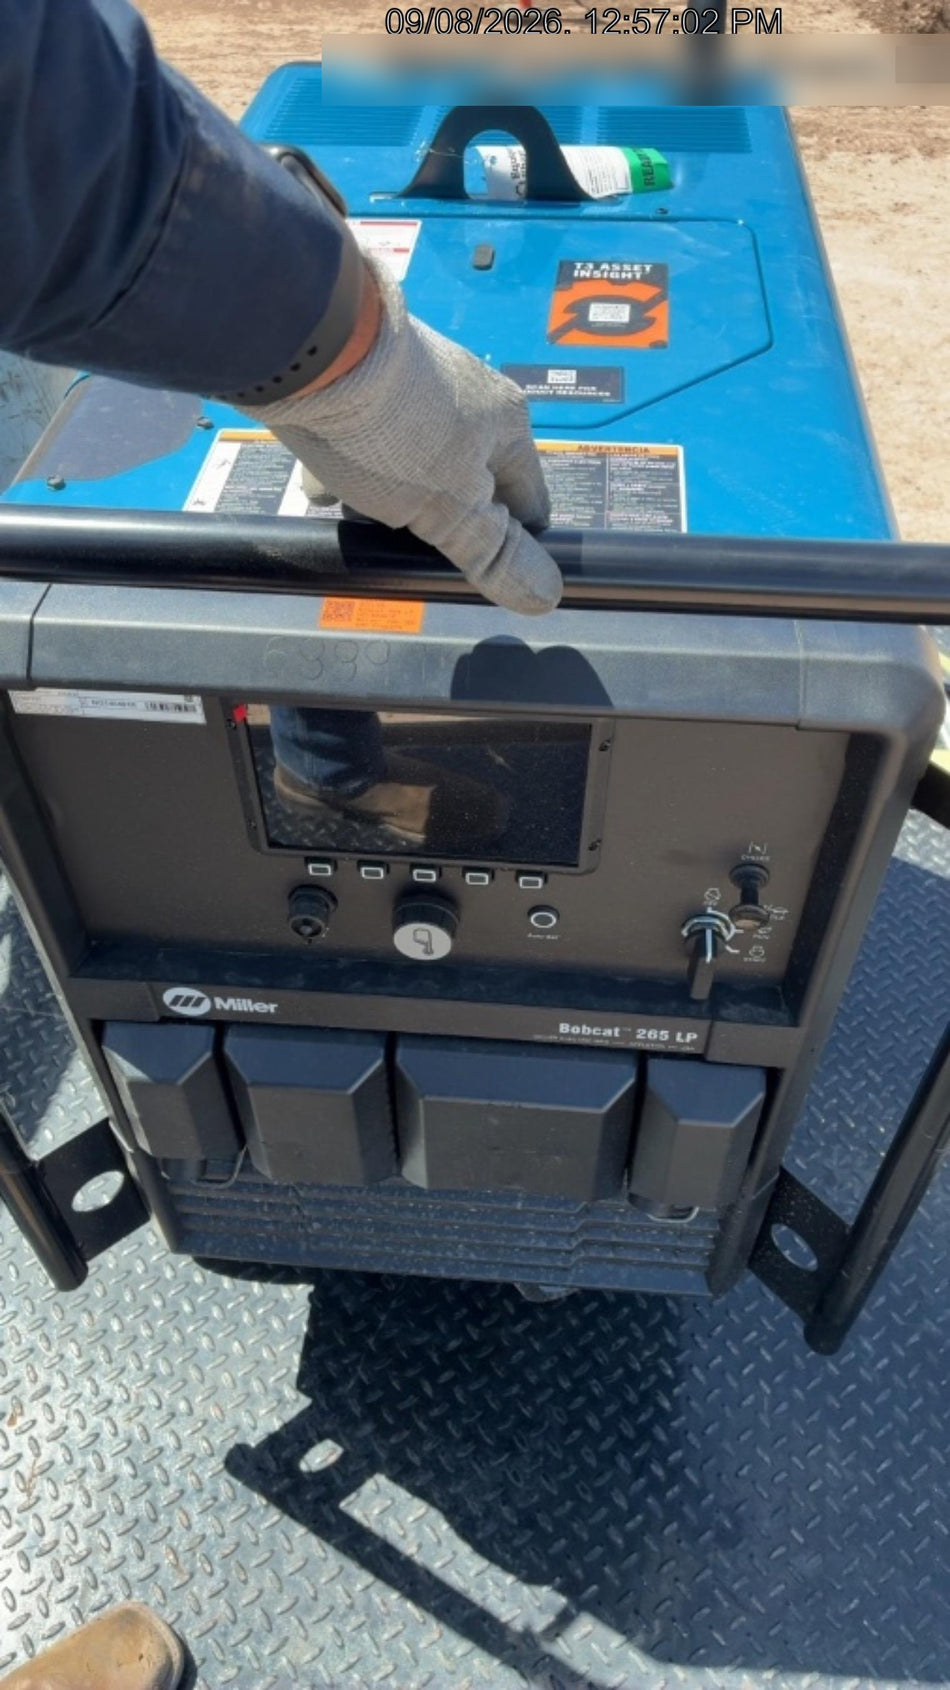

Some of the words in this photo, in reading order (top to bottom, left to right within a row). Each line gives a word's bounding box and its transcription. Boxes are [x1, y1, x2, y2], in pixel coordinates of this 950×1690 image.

[574, 262, 594, 271] T3
[600, 263, 653, 273] ASSET
[573, 270, 642, 280] INSIGHT
[213, 996, 279, 1014] Miller
[635, 1028, 670, 1042] 265
[675, 1031, 698, 1044] LP
